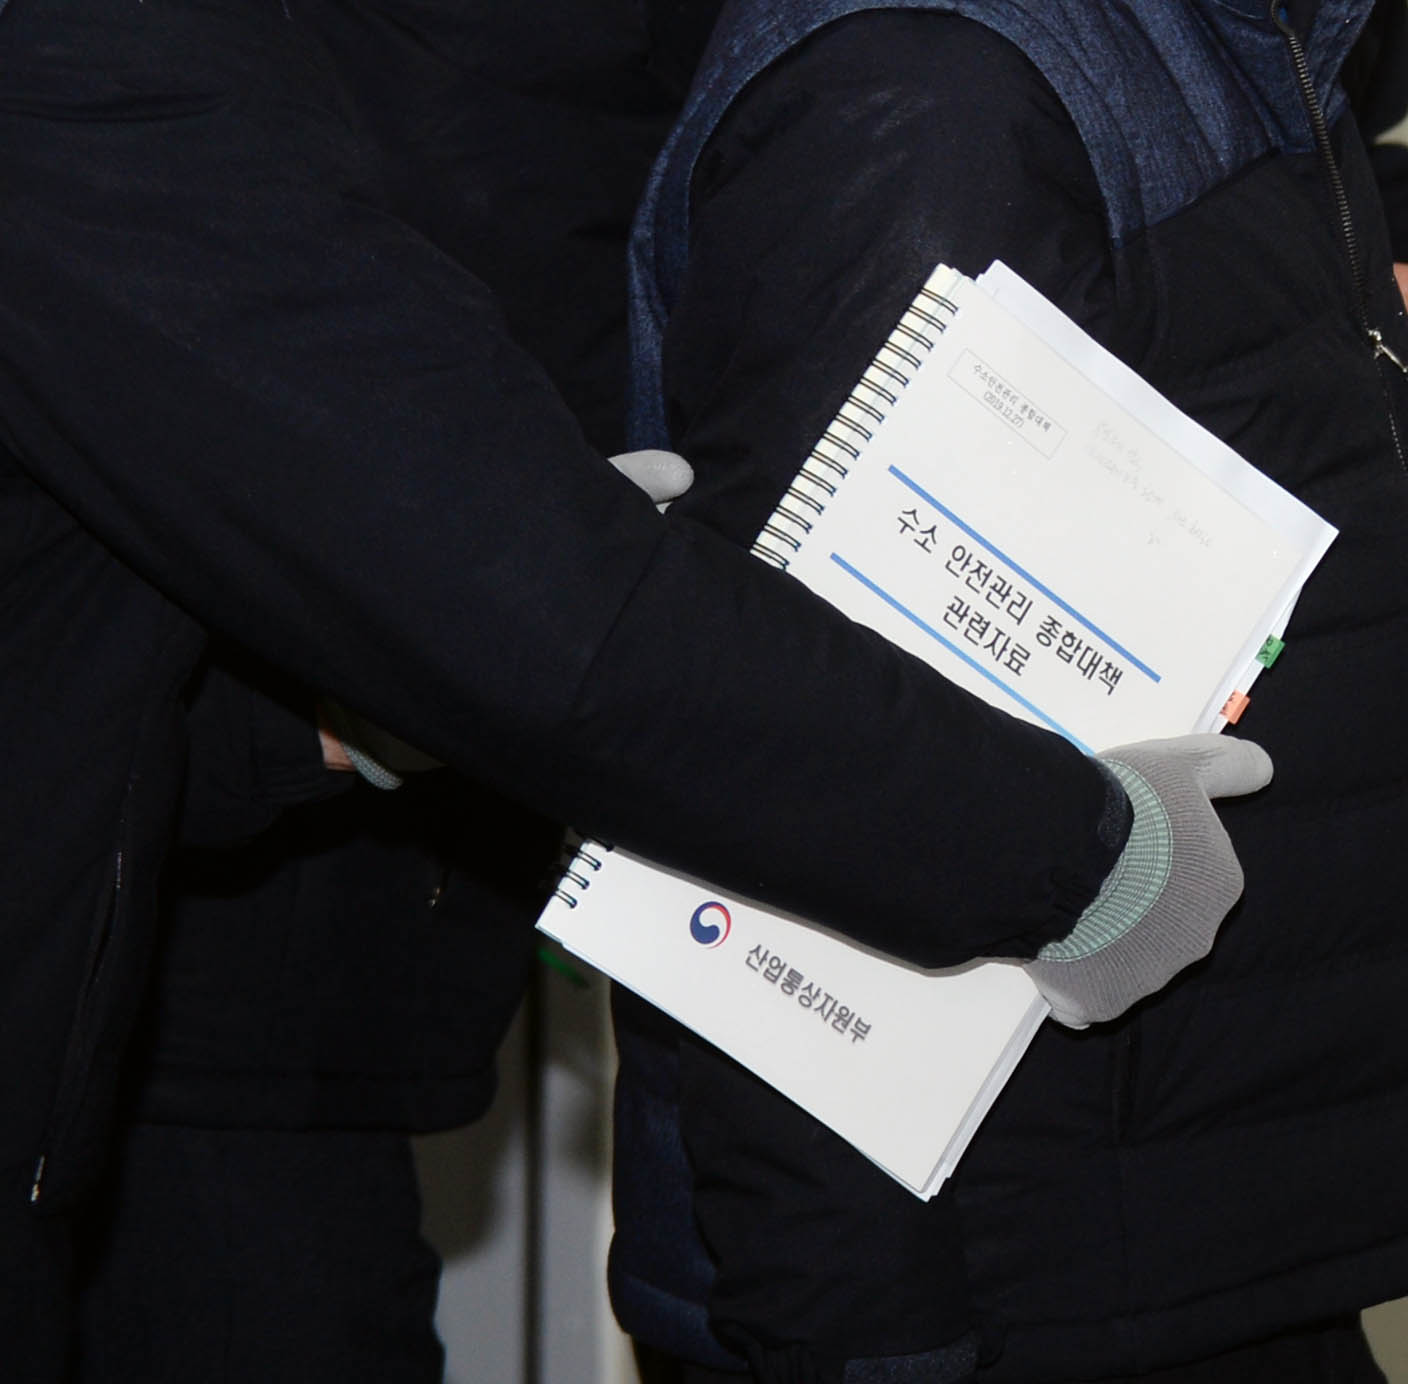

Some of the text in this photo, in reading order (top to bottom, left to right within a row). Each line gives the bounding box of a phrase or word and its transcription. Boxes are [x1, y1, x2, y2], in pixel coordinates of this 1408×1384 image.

[897, 507, 1124, 696] 수소 안전관리 종합대책
[942, 596, 1033, 676] 관련자료
[744, 943, 873, 1044] 산업통상자원부
